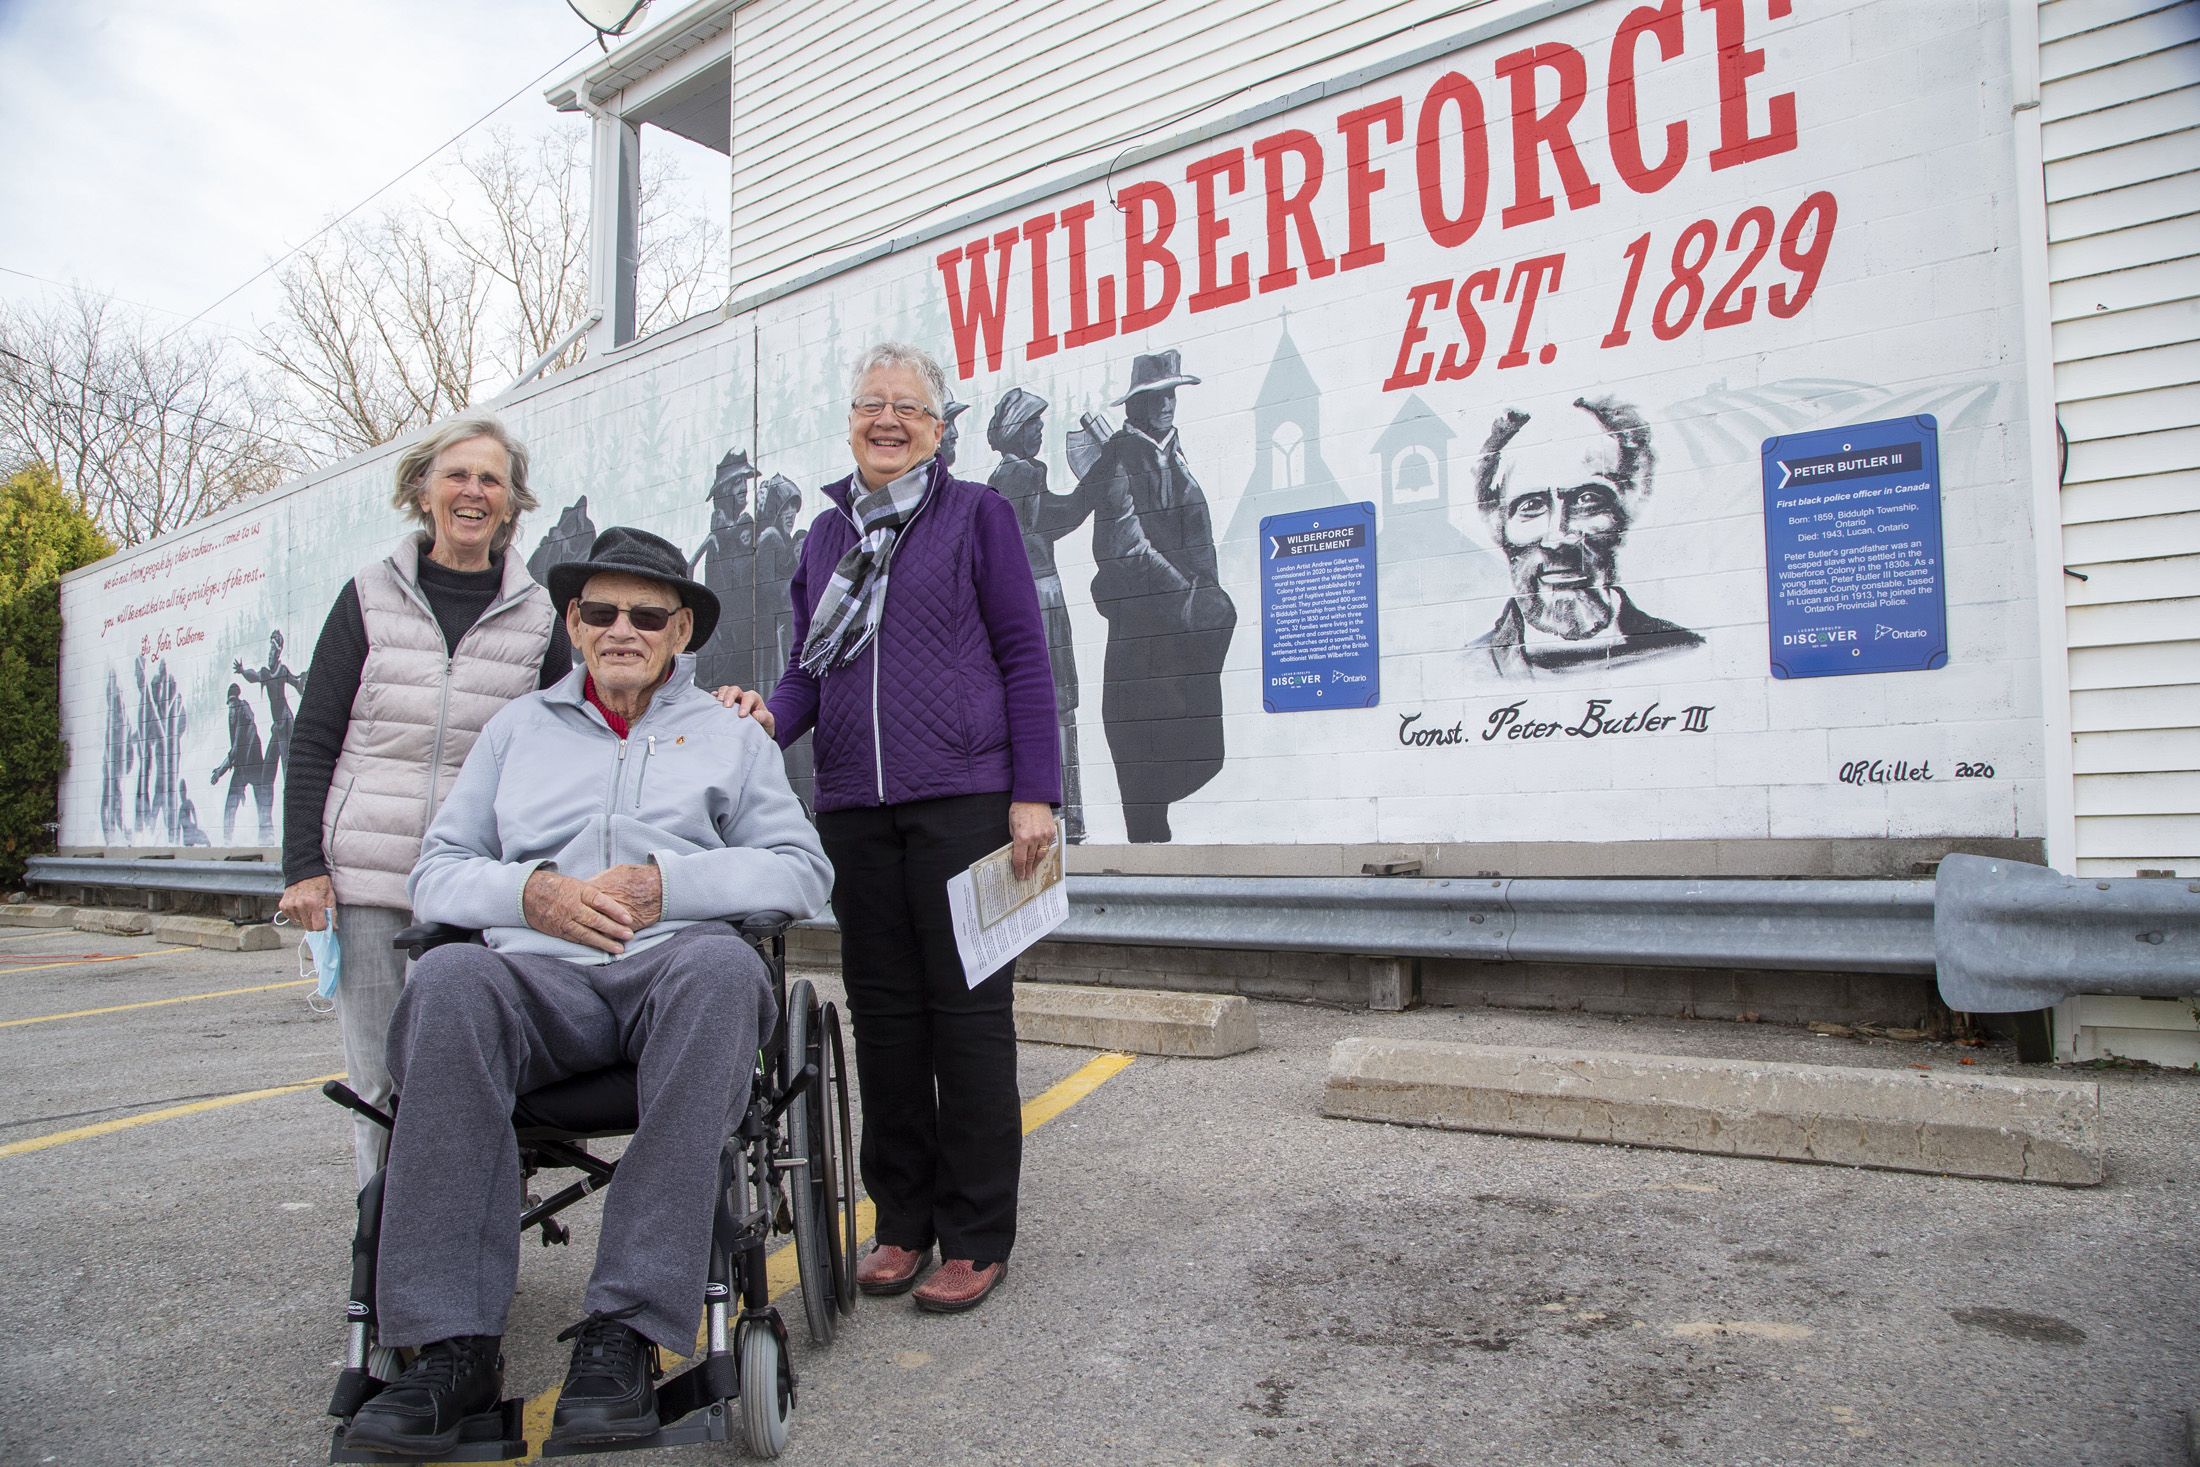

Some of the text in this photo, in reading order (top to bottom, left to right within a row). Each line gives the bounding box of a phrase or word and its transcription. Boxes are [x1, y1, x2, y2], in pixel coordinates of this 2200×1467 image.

[937, 0, 1798, 381] WILBERFORCE
[1382, 190, 1838, 393] EST. 1829
[1794, 453, 1902, 477] PETER BUTLER III
[1775, 481, 1930, 508] First black police officer in Canada
[1788, 502, 1919, 524] Born: 1859, Biddulph Township,
[1834, 517, 1866, 528] Ontario
[1286, 527, 1354, 544] WILBERFORCE
[1797, 522, 1909, 542] Died: 1943, Lucan, Ontario
[1290, 538, 1351, 554] SETTLEMENT
[1784, 551, 1805, 561] Peter
[1807, 548, 1838, 558] Butler's
[1840, 542, 1888, 556] grandfather
[1778, 568, 1824, 579] Wilberforce
[1826, 564, 1856, 576] Colony
[1857, 563, 1865, 571] in
[1867, 562, 1881, 570] the
[1884, 559, 1912, 569] 1830s.
[1914, 557, 1926, 566] As
[1787, 549, 1922, 571] escaped slave who settled in the
[1781, 567, 1928, 590] young man, Peter Butler III became
[1786, 586, 1827, 597] Middlesex
[1829, 583, 1859, 594] County
[1861, 579, 1905, 591] constable,
[1907, 576, 1934, 585] based
[1786, 585, 1932, 606] in Lucan and in 1913, he joined the
[1804, 597, 1908, 613] Ontario Provincial Police.
[1891, 628, 1927, 639] Ontario
[1343, 674, 1366, 682] Ontario
[1400, 712, 1469, 747] Const.
[1482, 699, 1563, 741] Peter
[1565, 699, 1677, 738] Butler
[1955, 761, 1995, 778] 2020
